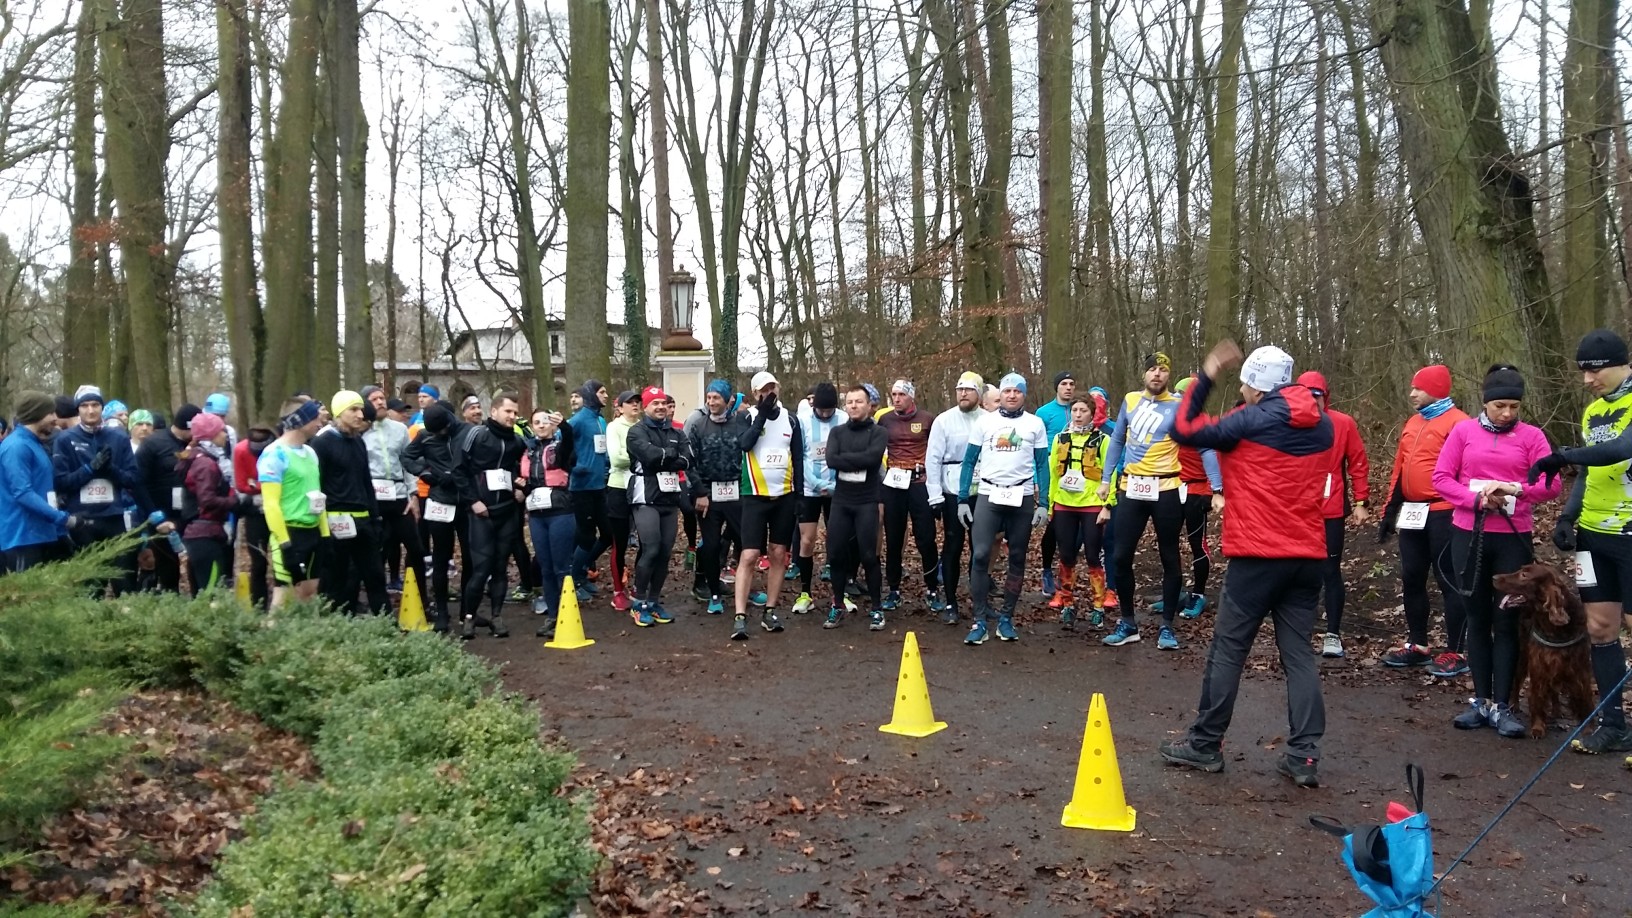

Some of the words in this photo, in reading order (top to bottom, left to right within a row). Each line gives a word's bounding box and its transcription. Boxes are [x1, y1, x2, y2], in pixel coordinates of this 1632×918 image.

[816, 447, 827, 456] 32
[767, 454, 783, 463] 277
[88, 486, 107, 496] 292
[717, 487, 733, 496] 332
[1133, 482, 1152, 493] 309
[1001, 491, 1012, 499] 52
[431, 505, 448, 515] 251
[1405, 511, 1422, 521] 250
[331, 522, 350, 532] 254
